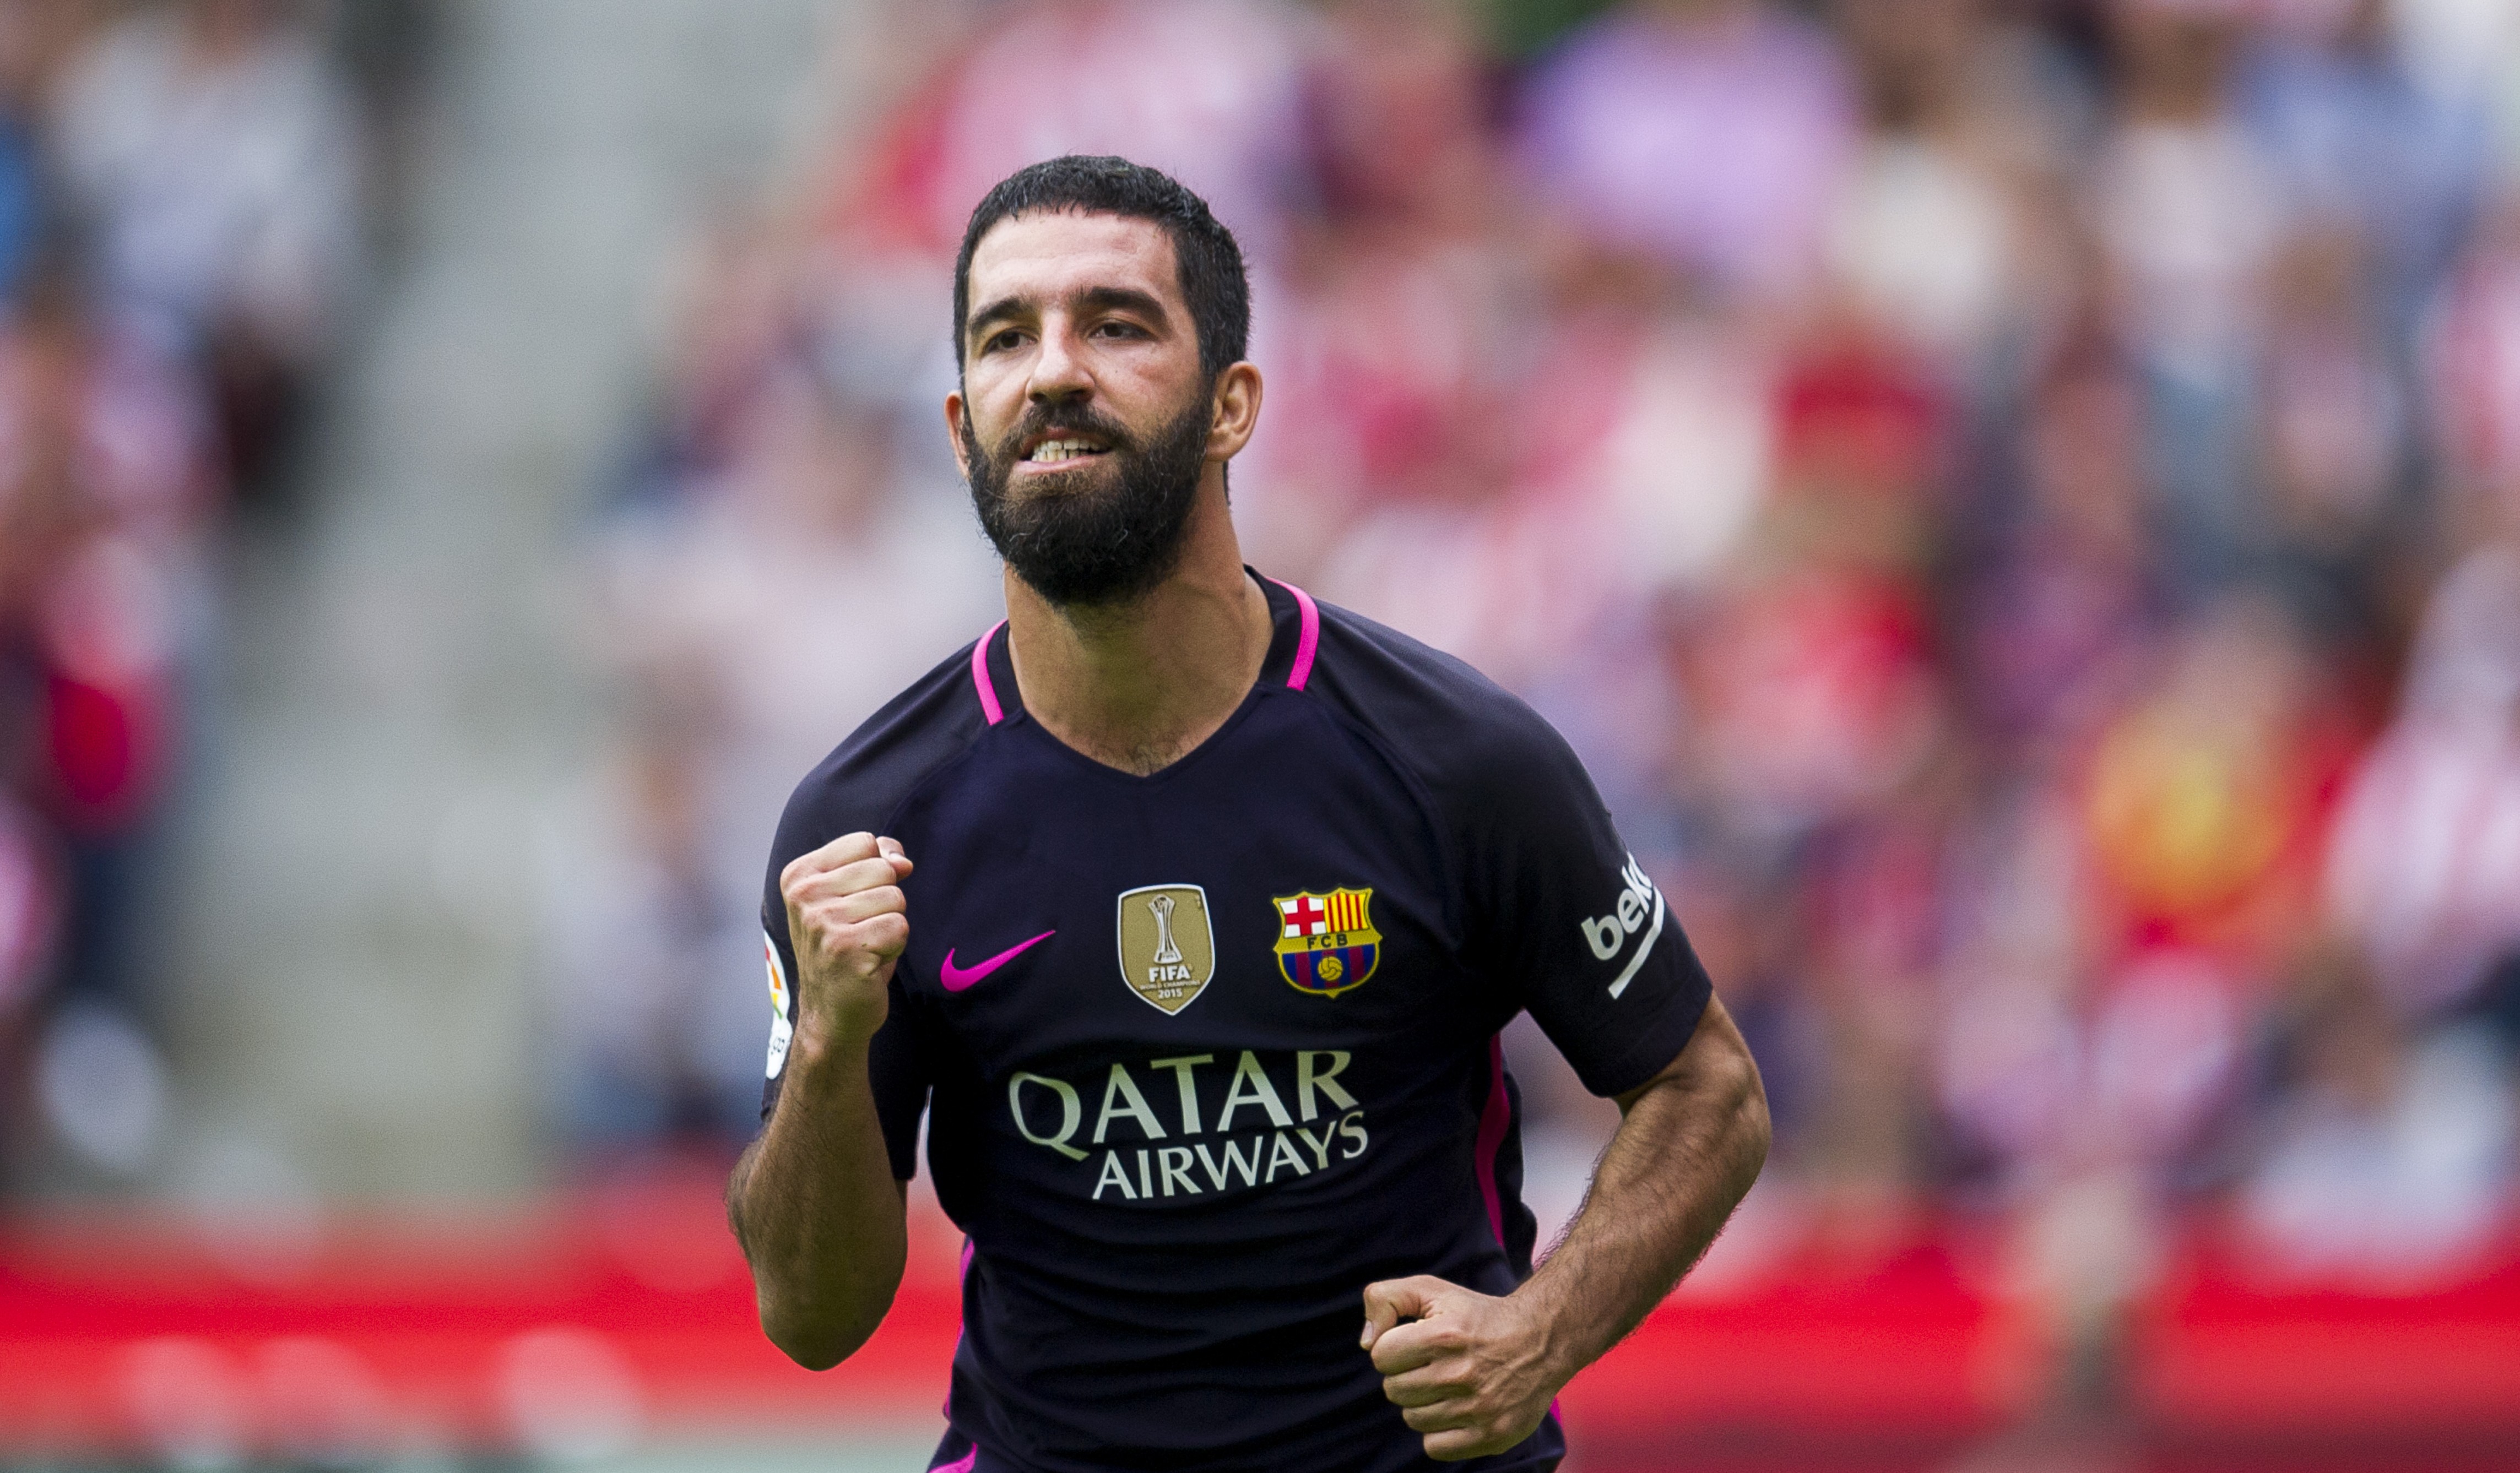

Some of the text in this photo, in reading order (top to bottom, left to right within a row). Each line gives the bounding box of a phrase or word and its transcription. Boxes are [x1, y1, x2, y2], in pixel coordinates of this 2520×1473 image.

[1148, 965, 1191, 983] FIFA
[1158, 988, 1183, 999] 2015
[1009, 1050, 1359, 1162] QATAR
[1092, 1111, 1369, 1200] AIRWAYS
